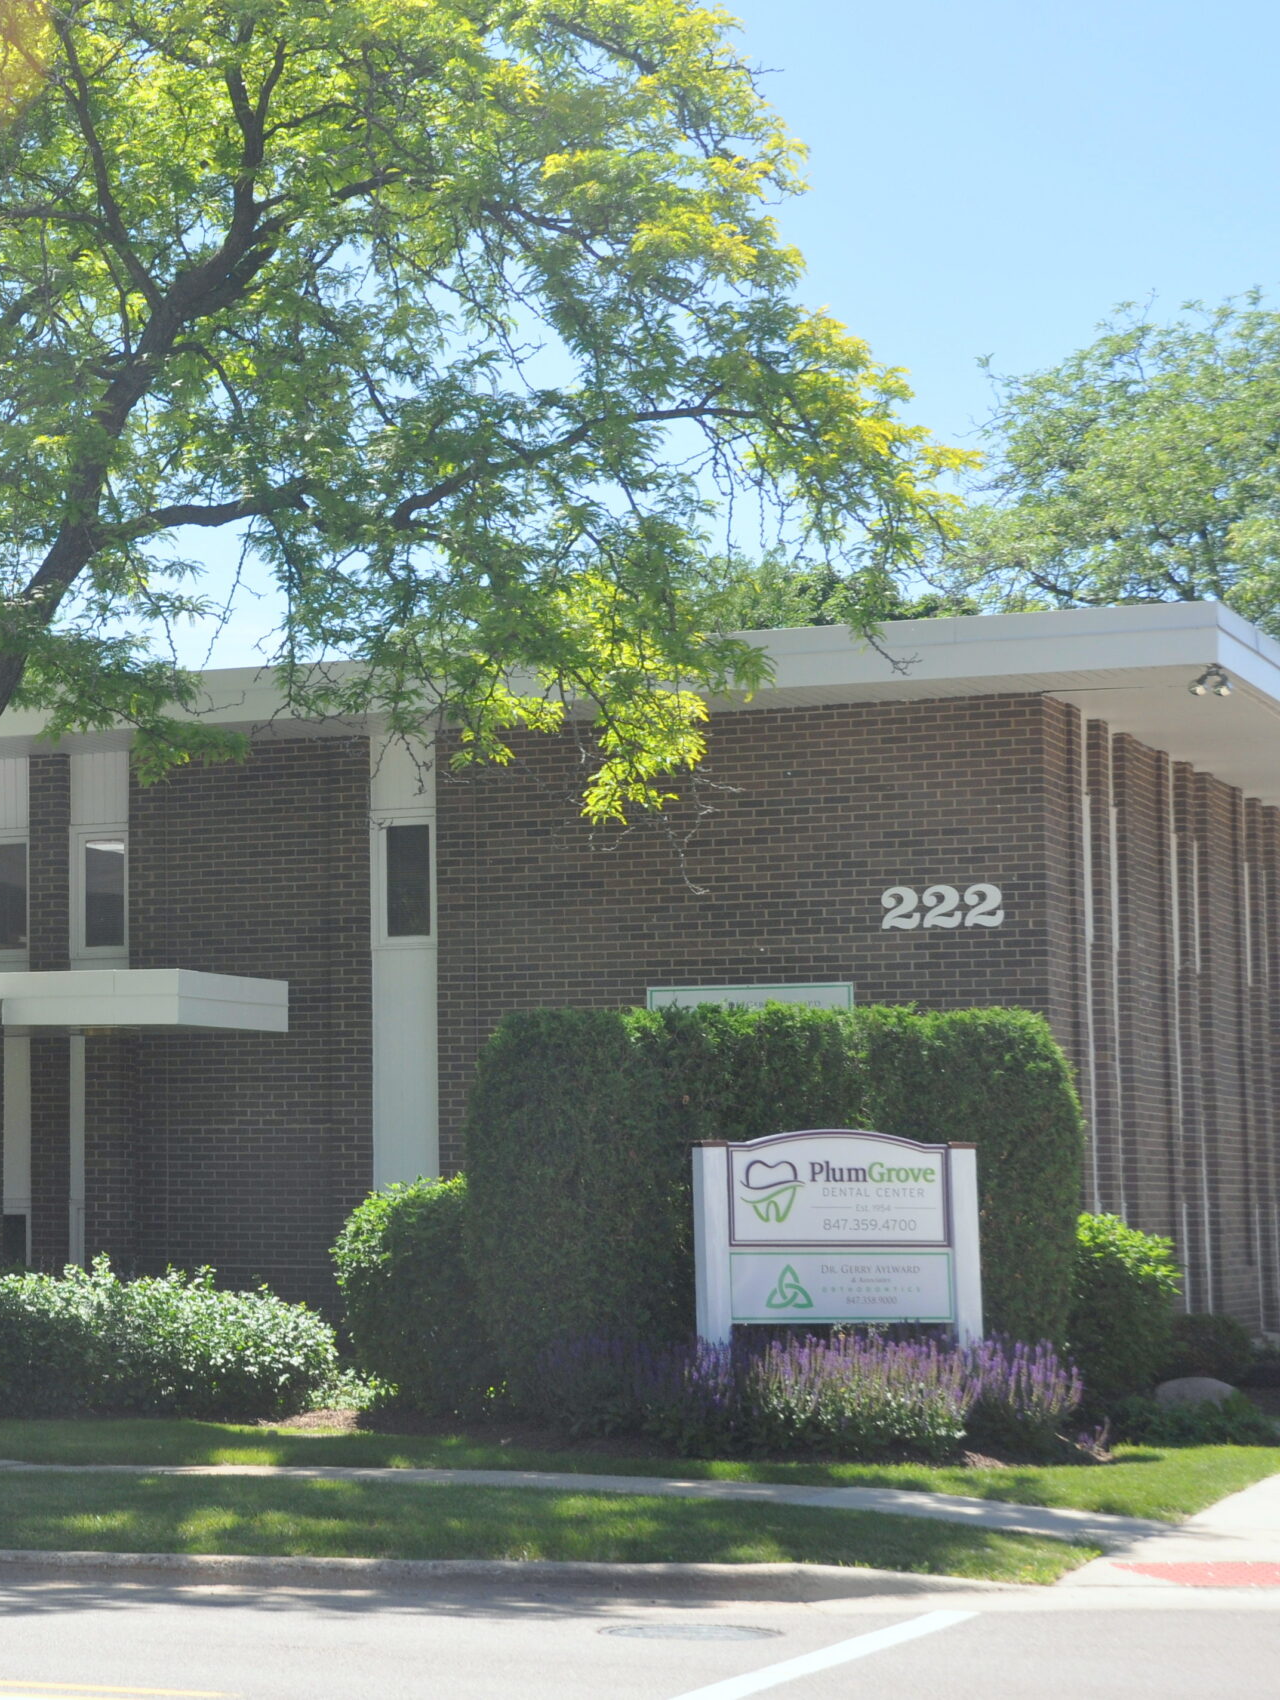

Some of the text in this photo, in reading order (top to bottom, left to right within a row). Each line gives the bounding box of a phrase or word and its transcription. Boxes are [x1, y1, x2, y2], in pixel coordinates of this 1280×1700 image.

[880, 883, 1005, 930] 222
[808, 1160, 937, 1184] PlumGrove
[822, 1187, 926, 1198] DENTAL CENTER
[872, 1204, 892, 1213] 1954
[823, 1218, 918, 1232] 847.359.4700
